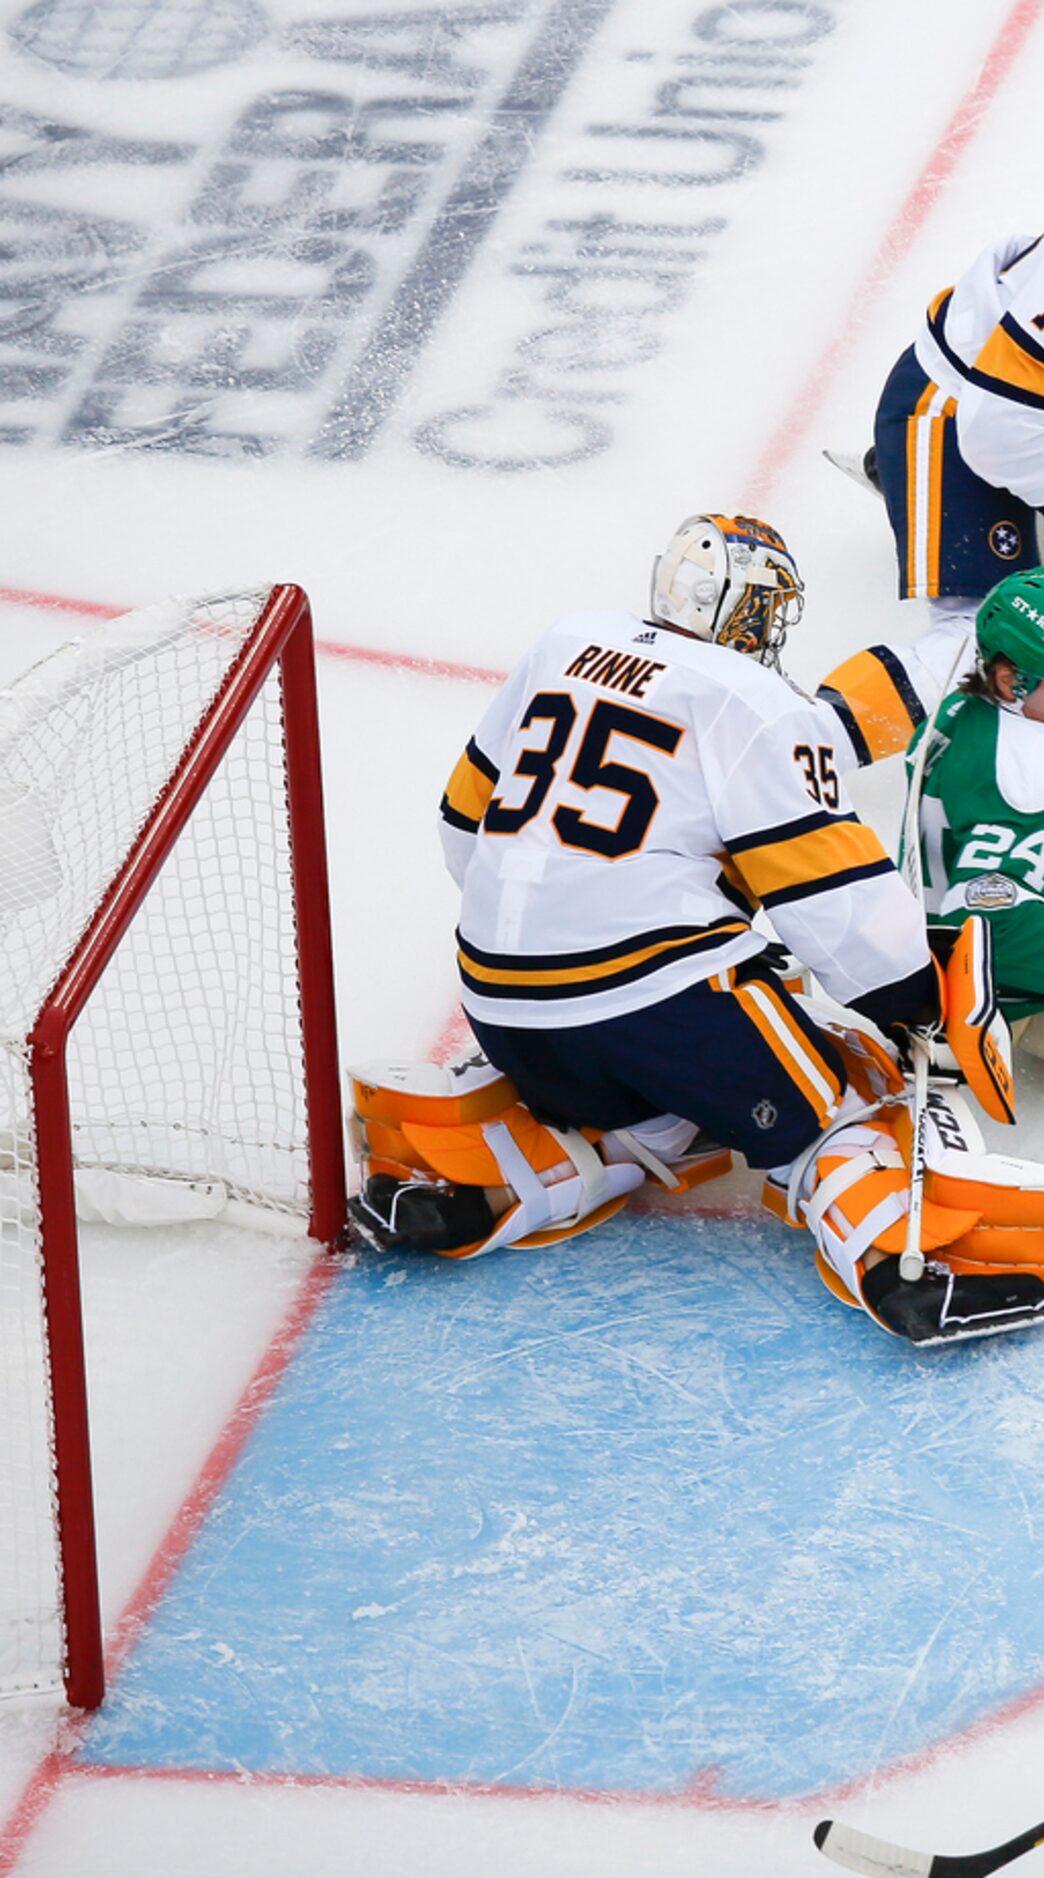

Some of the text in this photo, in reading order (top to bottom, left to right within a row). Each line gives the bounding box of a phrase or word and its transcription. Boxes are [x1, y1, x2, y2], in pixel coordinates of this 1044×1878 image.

[411, 214, 729, 473] Credit
[564, 643, 667, 699] RINNE
[483, 691, 686, 861] 35
[793, 744, 840, 809] 35
